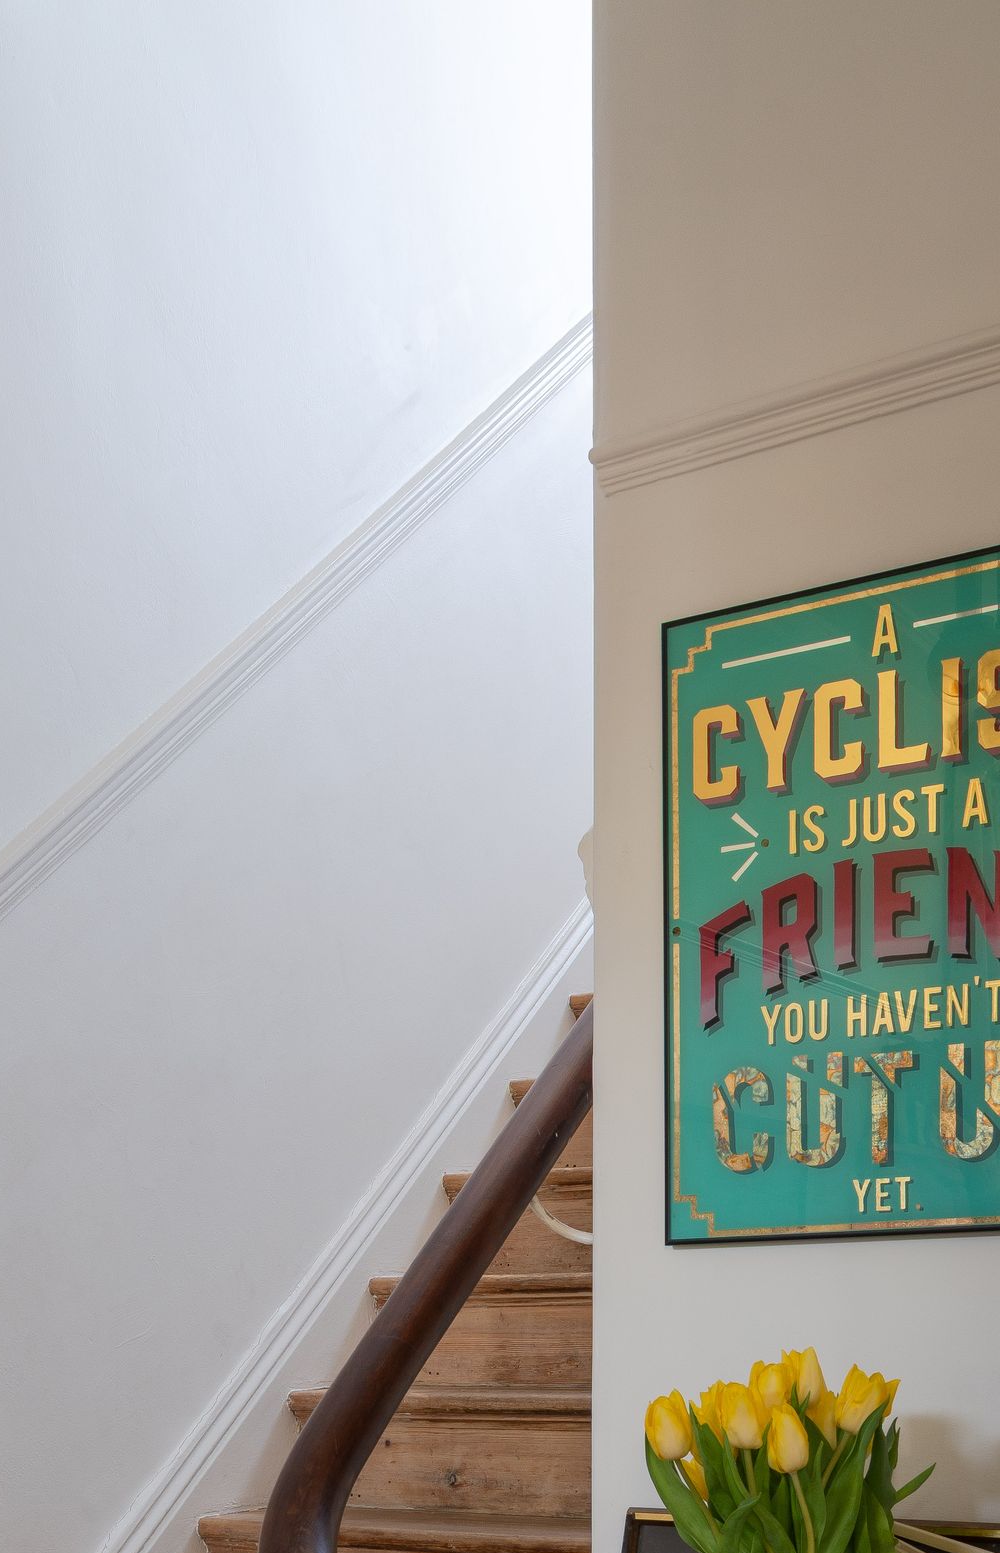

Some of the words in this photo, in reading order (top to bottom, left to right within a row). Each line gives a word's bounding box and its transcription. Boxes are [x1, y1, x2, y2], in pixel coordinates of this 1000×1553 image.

[871, 603, 899, 658] A
[788, 804, 826, 855] IS
[841, 783, 945, 847] JUST
[961, 777, 989, 829] A
[698, 847, 1000, 1032] FRIEN
[760, 998, 829, 1046] YOU
[846, 975, 1000, 1038] HAVEN'T
[712, 1050, 914, 1173] CUT
